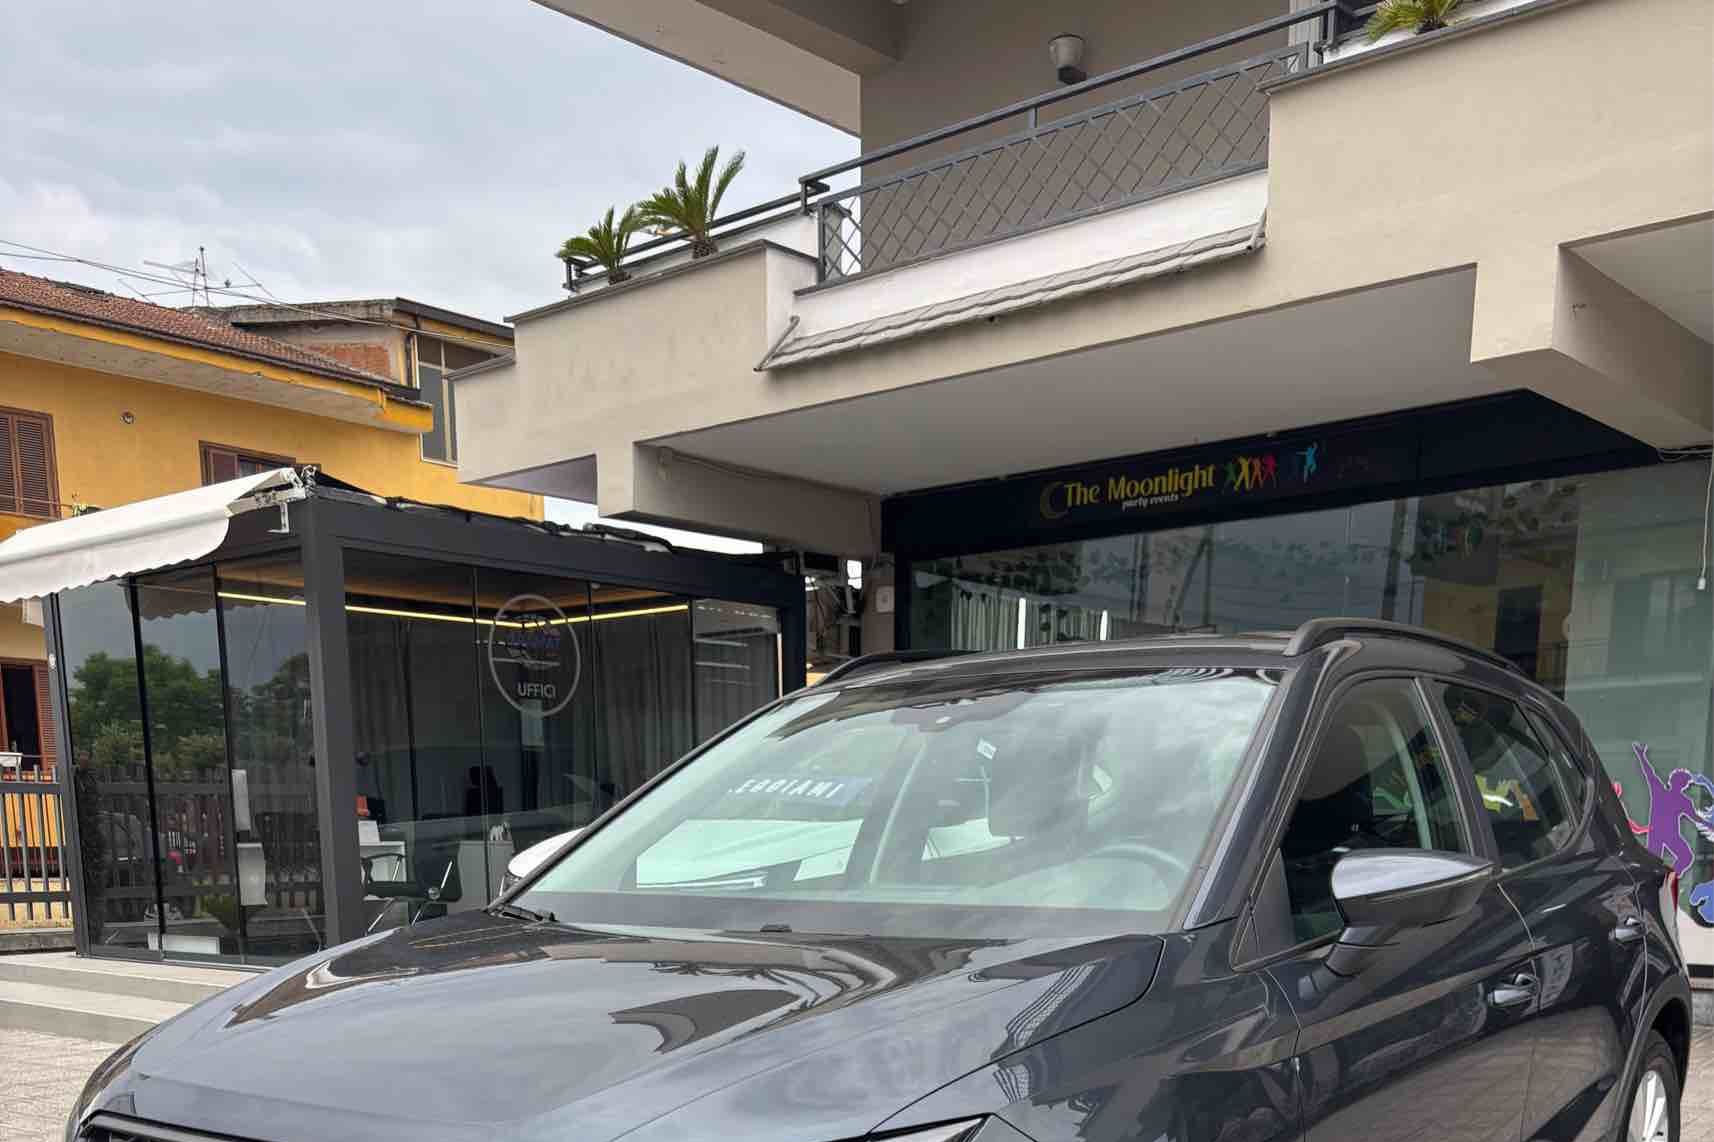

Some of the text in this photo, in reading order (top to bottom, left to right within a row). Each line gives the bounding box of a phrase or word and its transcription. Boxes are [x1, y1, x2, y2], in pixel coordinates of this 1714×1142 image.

[1064, 463, 1216, 507] The Moonlight
[1122, 493, 1179, 512] party events
[517, 682, 556, 699] UFFICI
